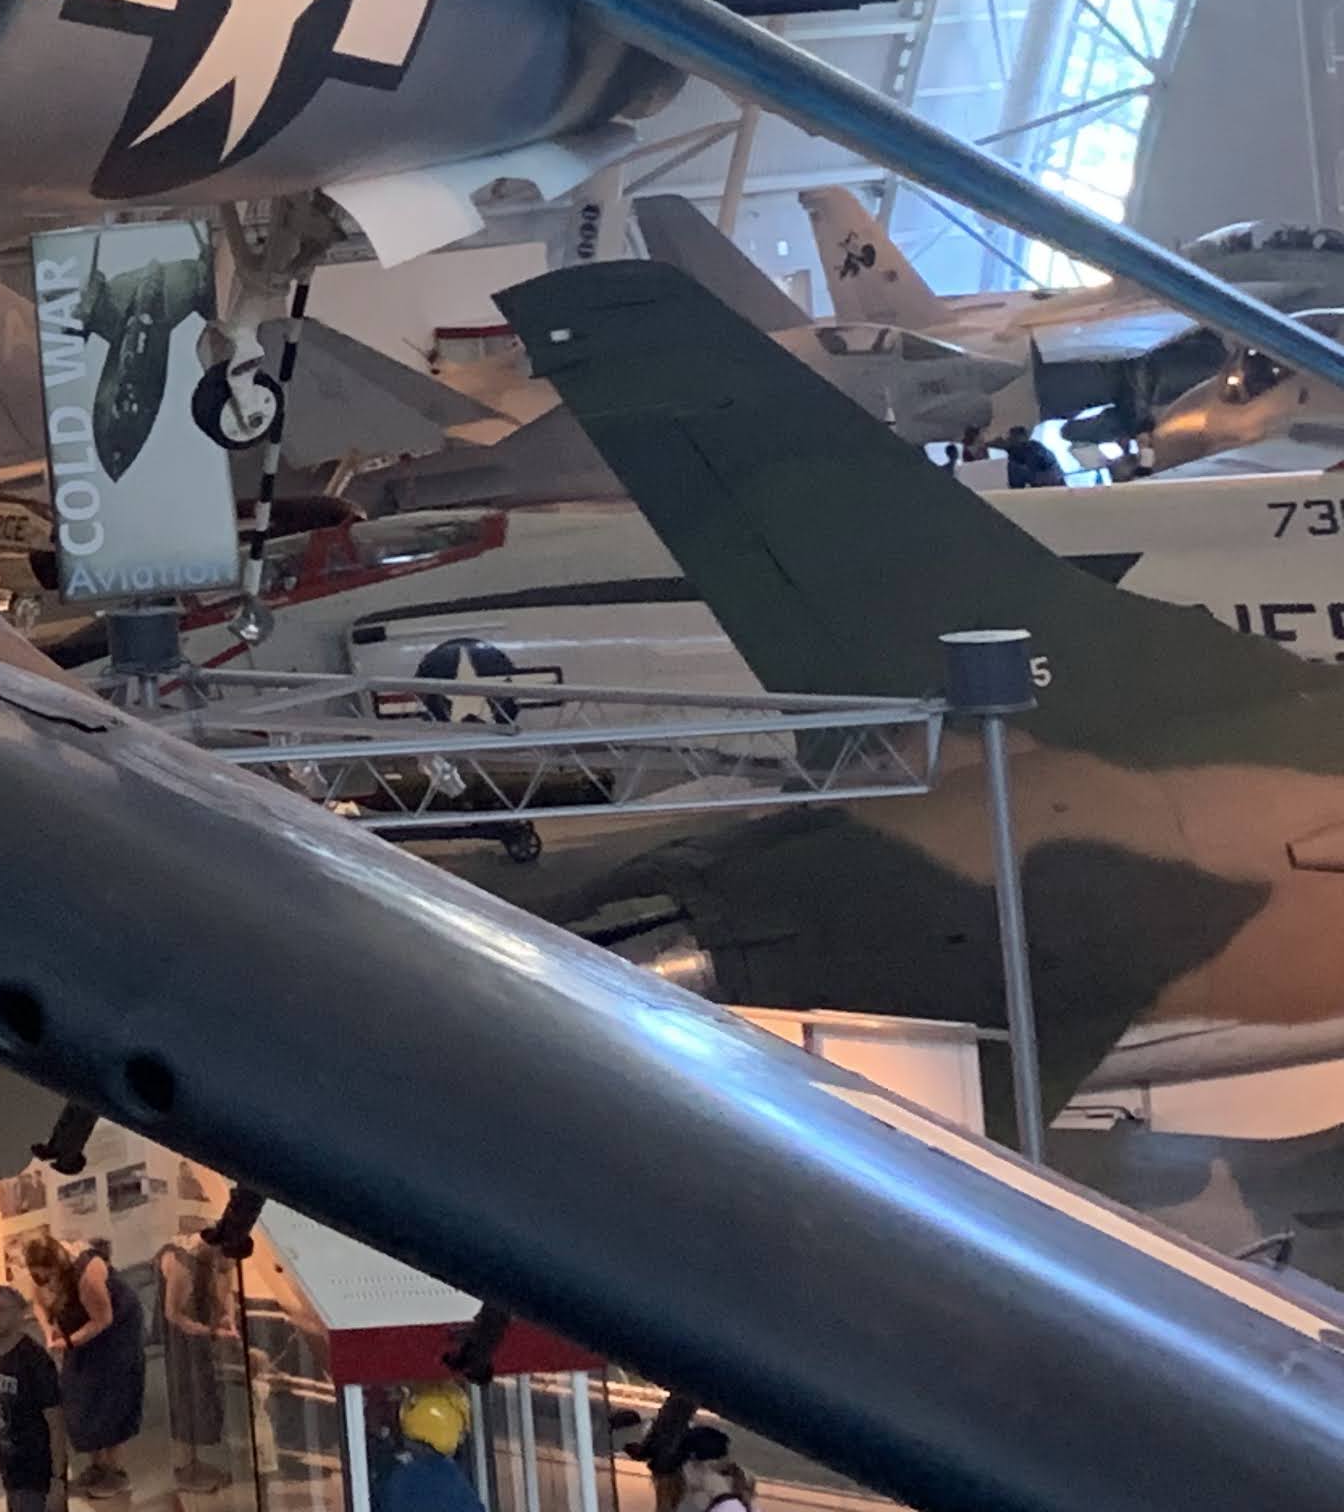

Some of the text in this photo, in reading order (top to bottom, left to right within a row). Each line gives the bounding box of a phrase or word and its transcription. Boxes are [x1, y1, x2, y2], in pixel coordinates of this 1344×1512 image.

[35, 255, 105, 557] COLD WAR
[1267, 498, 1344, 538] 73
